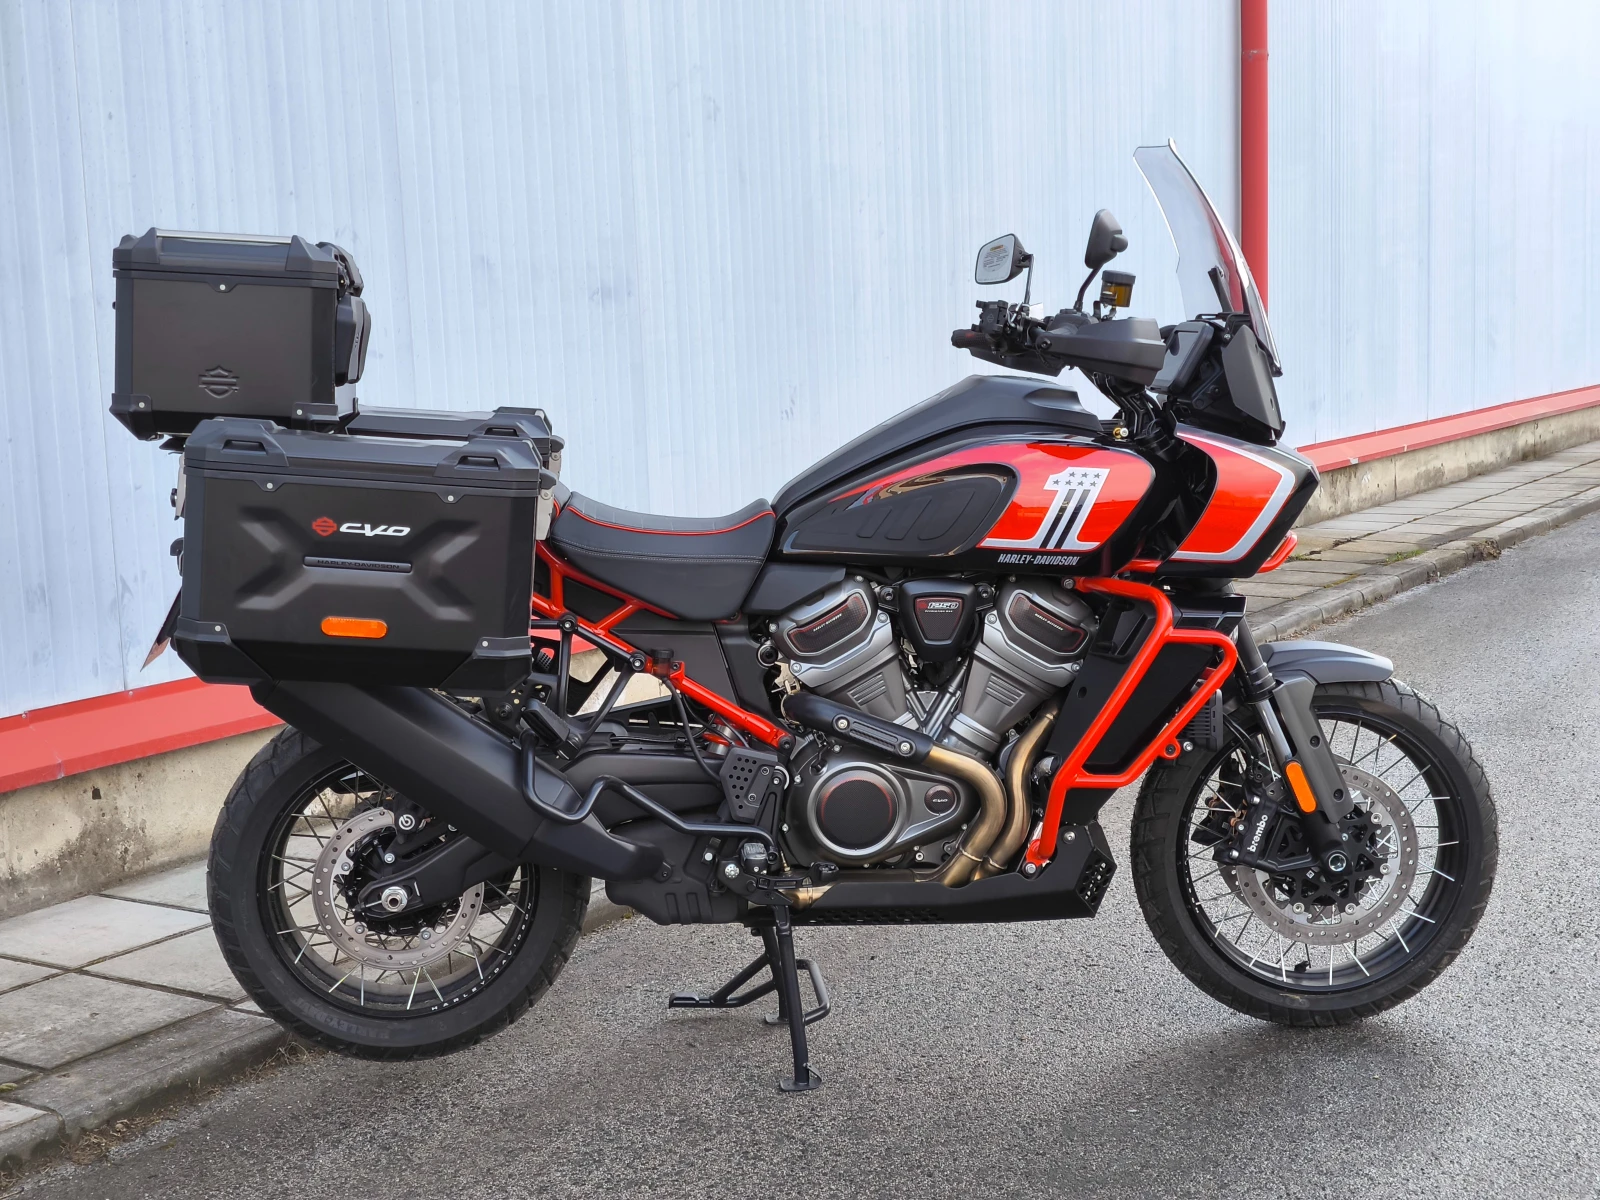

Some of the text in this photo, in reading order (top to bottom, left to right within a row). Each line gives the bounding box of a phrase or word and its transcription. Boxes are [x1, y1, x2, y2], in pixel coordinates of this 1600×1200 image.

[339, 522, 411, 537] CVO
[317, 559, 400, 570] HARLEY-DAVIDSON
[997, 553, 1080, 566] HARLEY-DAVIDSON
[1246, 814, 1268, 853] brembo
